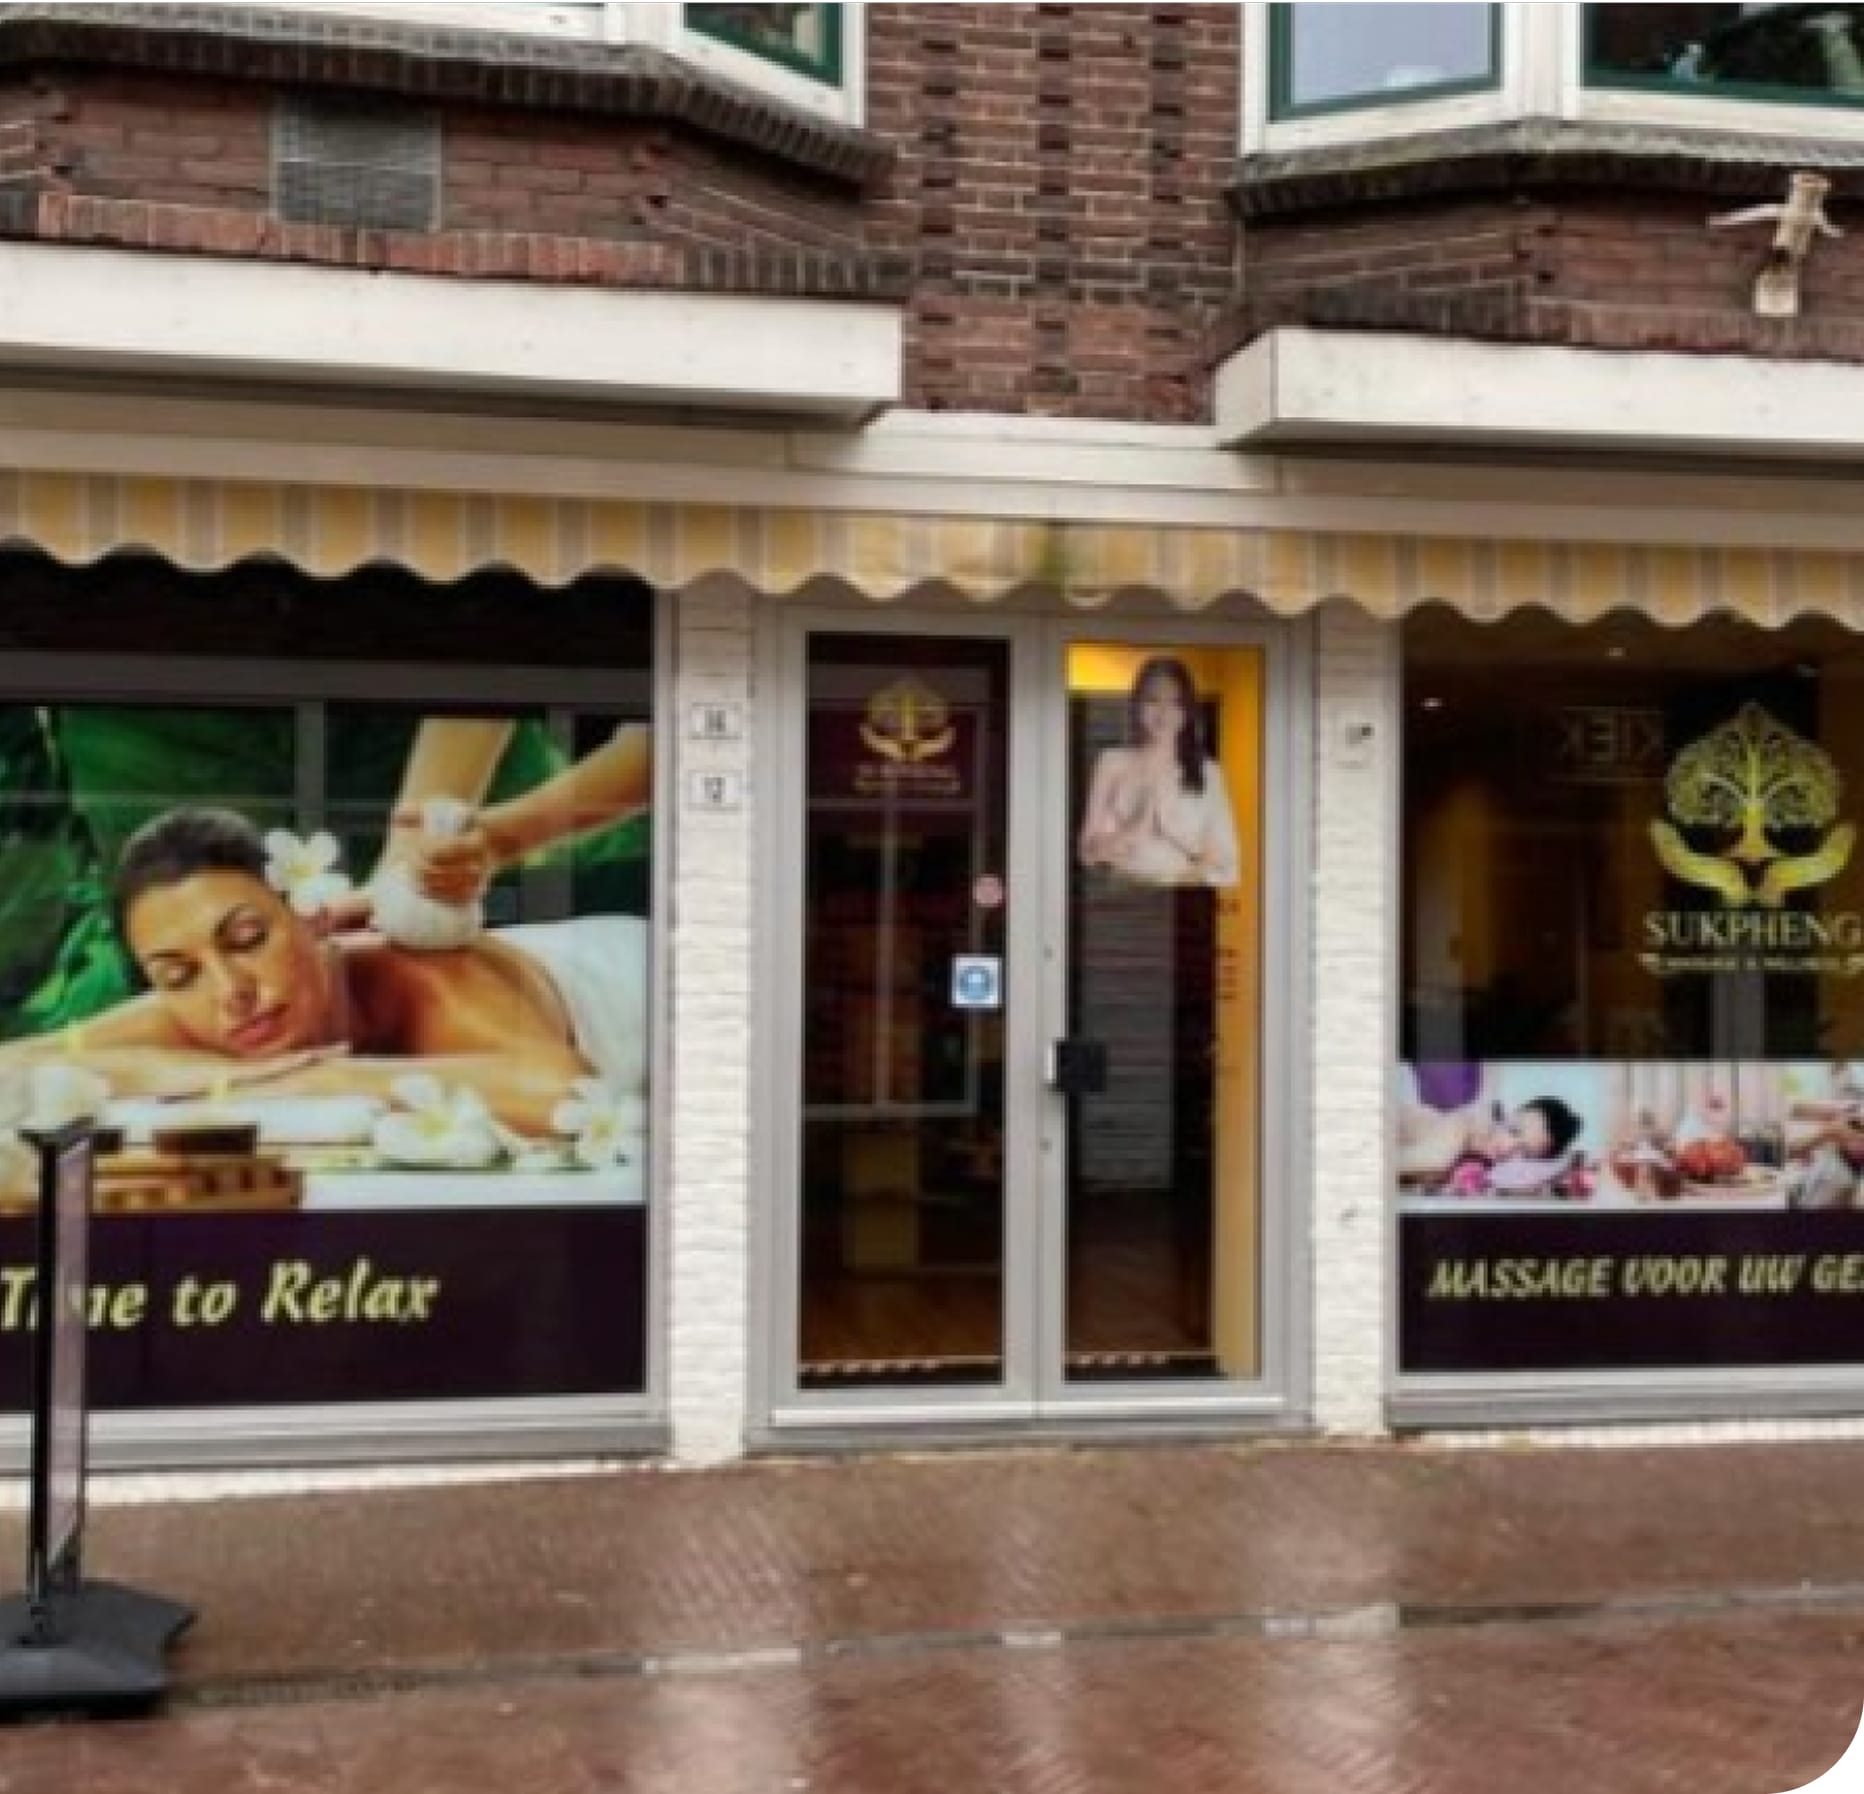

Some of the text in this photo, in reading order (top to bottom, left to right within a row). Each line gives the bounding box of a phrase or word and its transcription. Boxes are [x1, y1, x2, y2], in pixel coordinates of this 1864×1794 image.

[1643, 911, 1864, 947] SUKPHENG
[172, 1276, 238, 1326] to
[262, 1256, 440, 1323] Relax
[1428, 1258, 1613, 1297] MASSAGE
[1622, 1256, 1727, 1295] VOOR
[1739, 1255, 1806, 1293] UW
